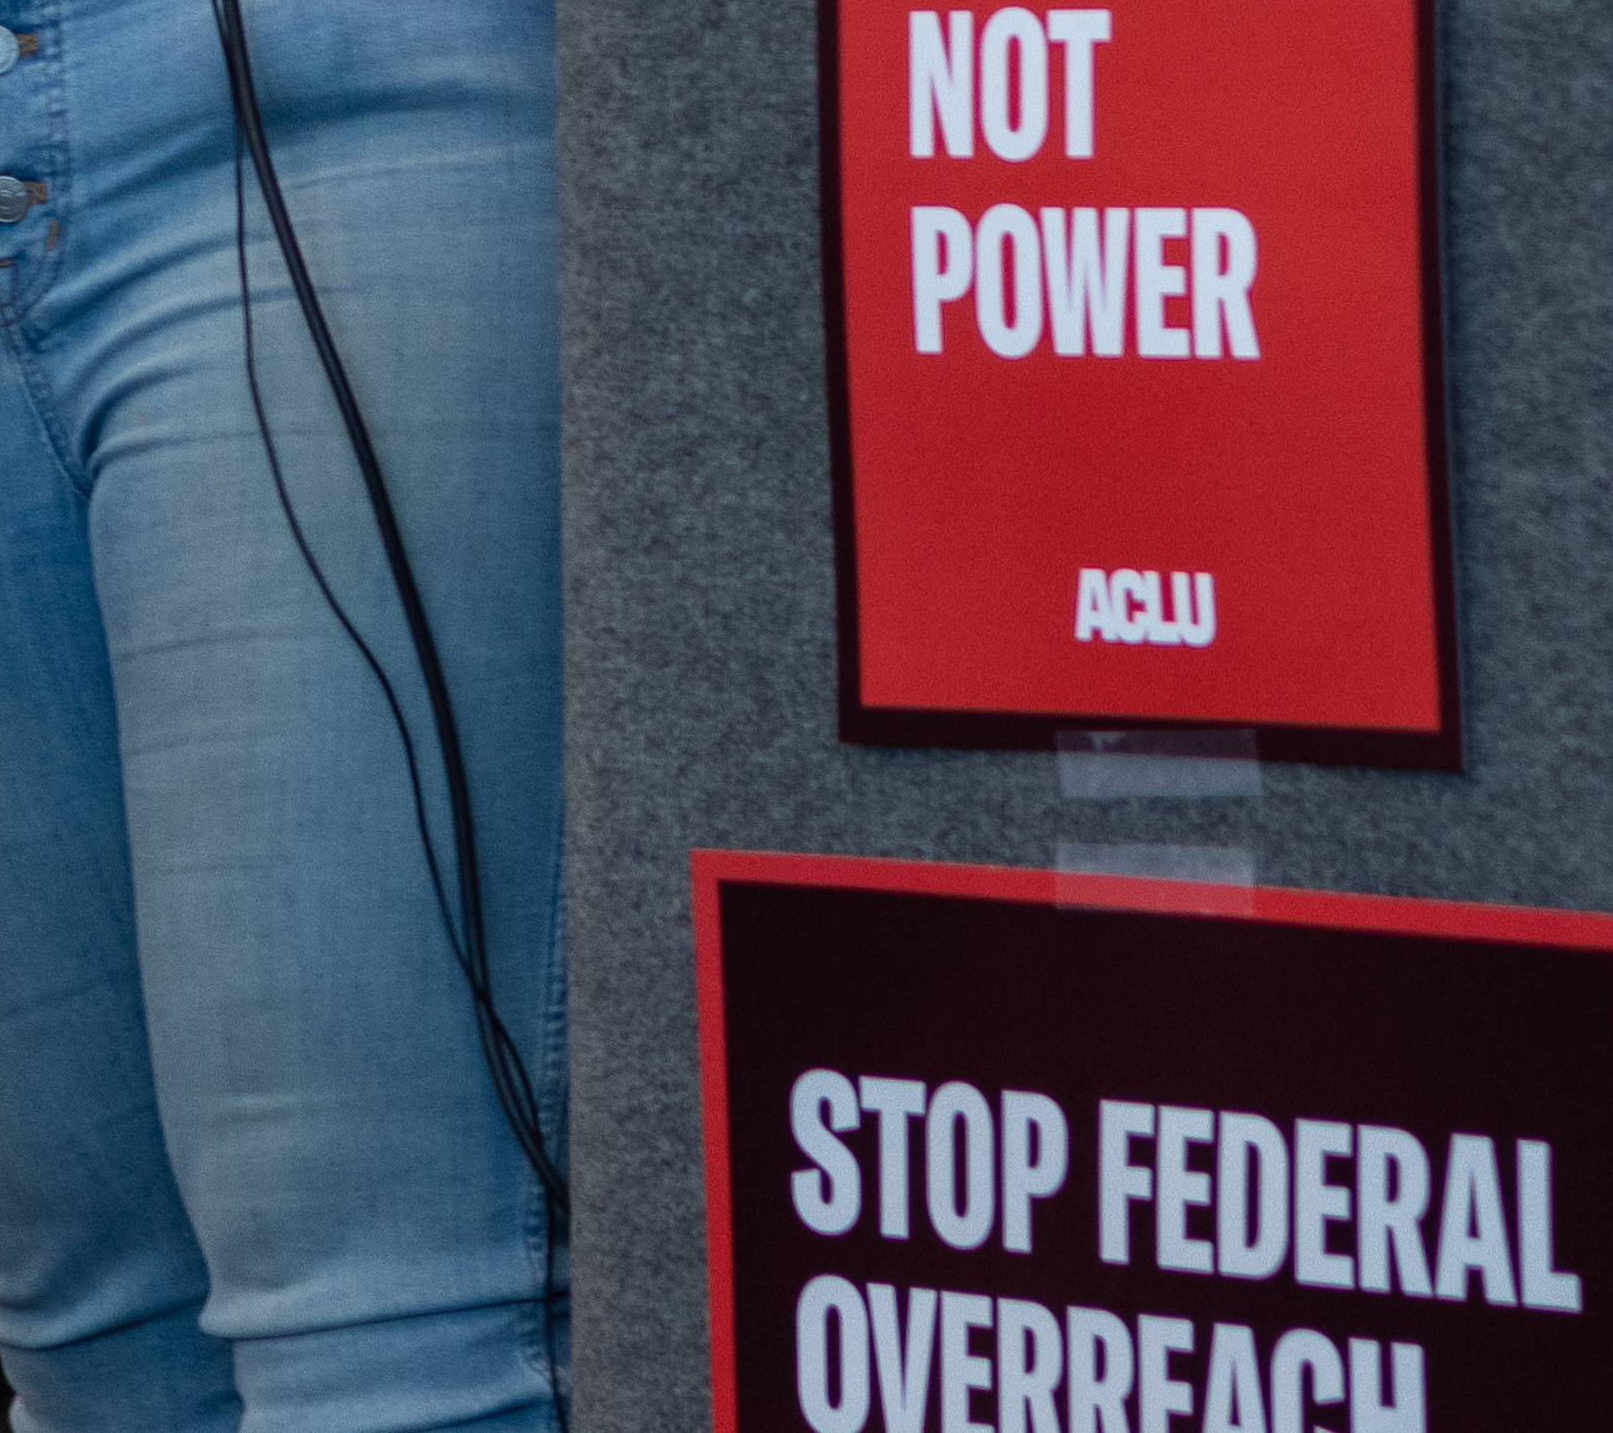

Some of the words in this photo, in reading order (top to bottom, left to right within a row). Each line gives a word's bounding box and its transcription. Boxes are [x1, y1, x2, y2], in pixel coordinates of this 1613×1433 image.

[909, 6, 1112, 163] NOT
[911, 203, 1260, 360] POWER
[1074, 567, 1215, 647] ACLU
[789, 1067, 1069, 1254] STOP
[1098, 1099, 1582, 1312] FEDERAL
[796, 1274, 1426, 1433] OVERREACH
